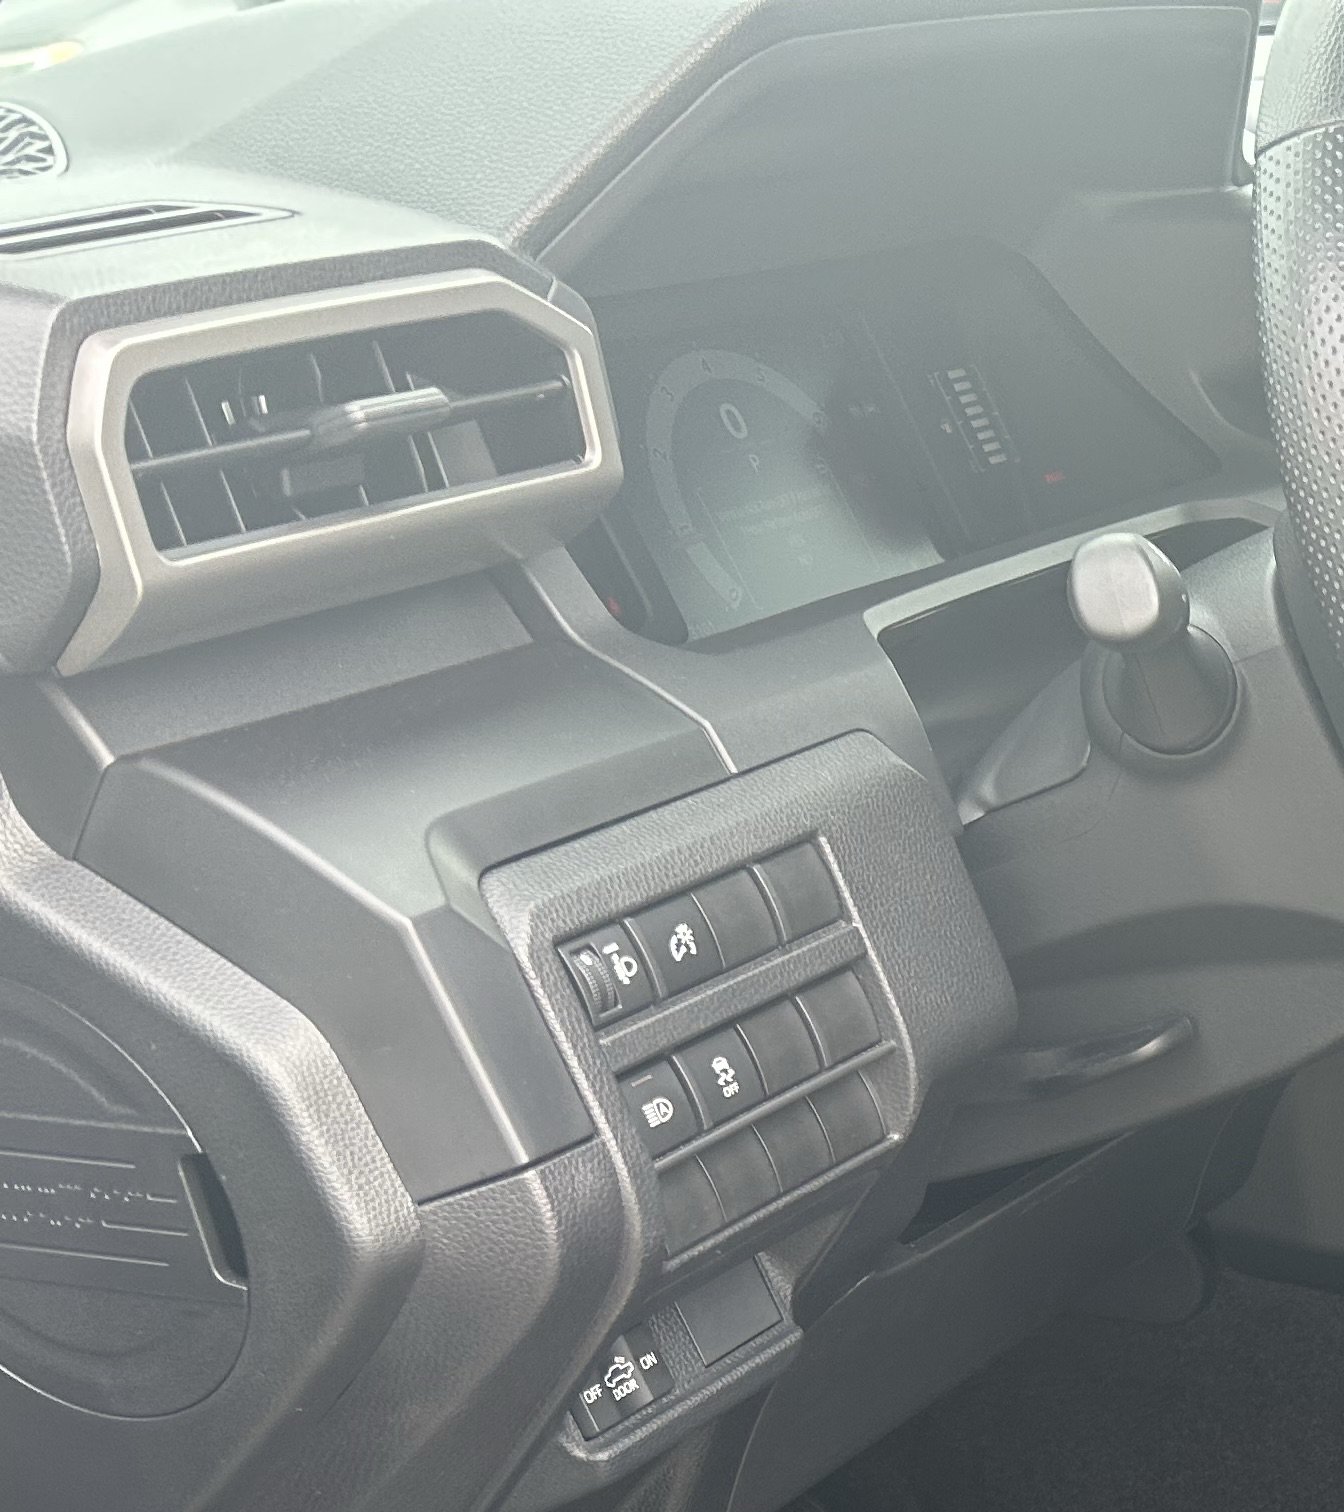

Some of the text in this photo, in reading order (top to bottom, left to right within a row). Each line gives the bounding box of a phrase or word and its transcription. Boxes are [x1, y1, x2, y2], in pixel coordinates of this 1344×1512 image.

[719, 402, 748, 439] 0
[748, 453, 760, 473] P
[639, 1351, 658, 1370] ON
[583, 1383, 603, 1404] OFF
[612, 1378, 640, 1402] DOOR
